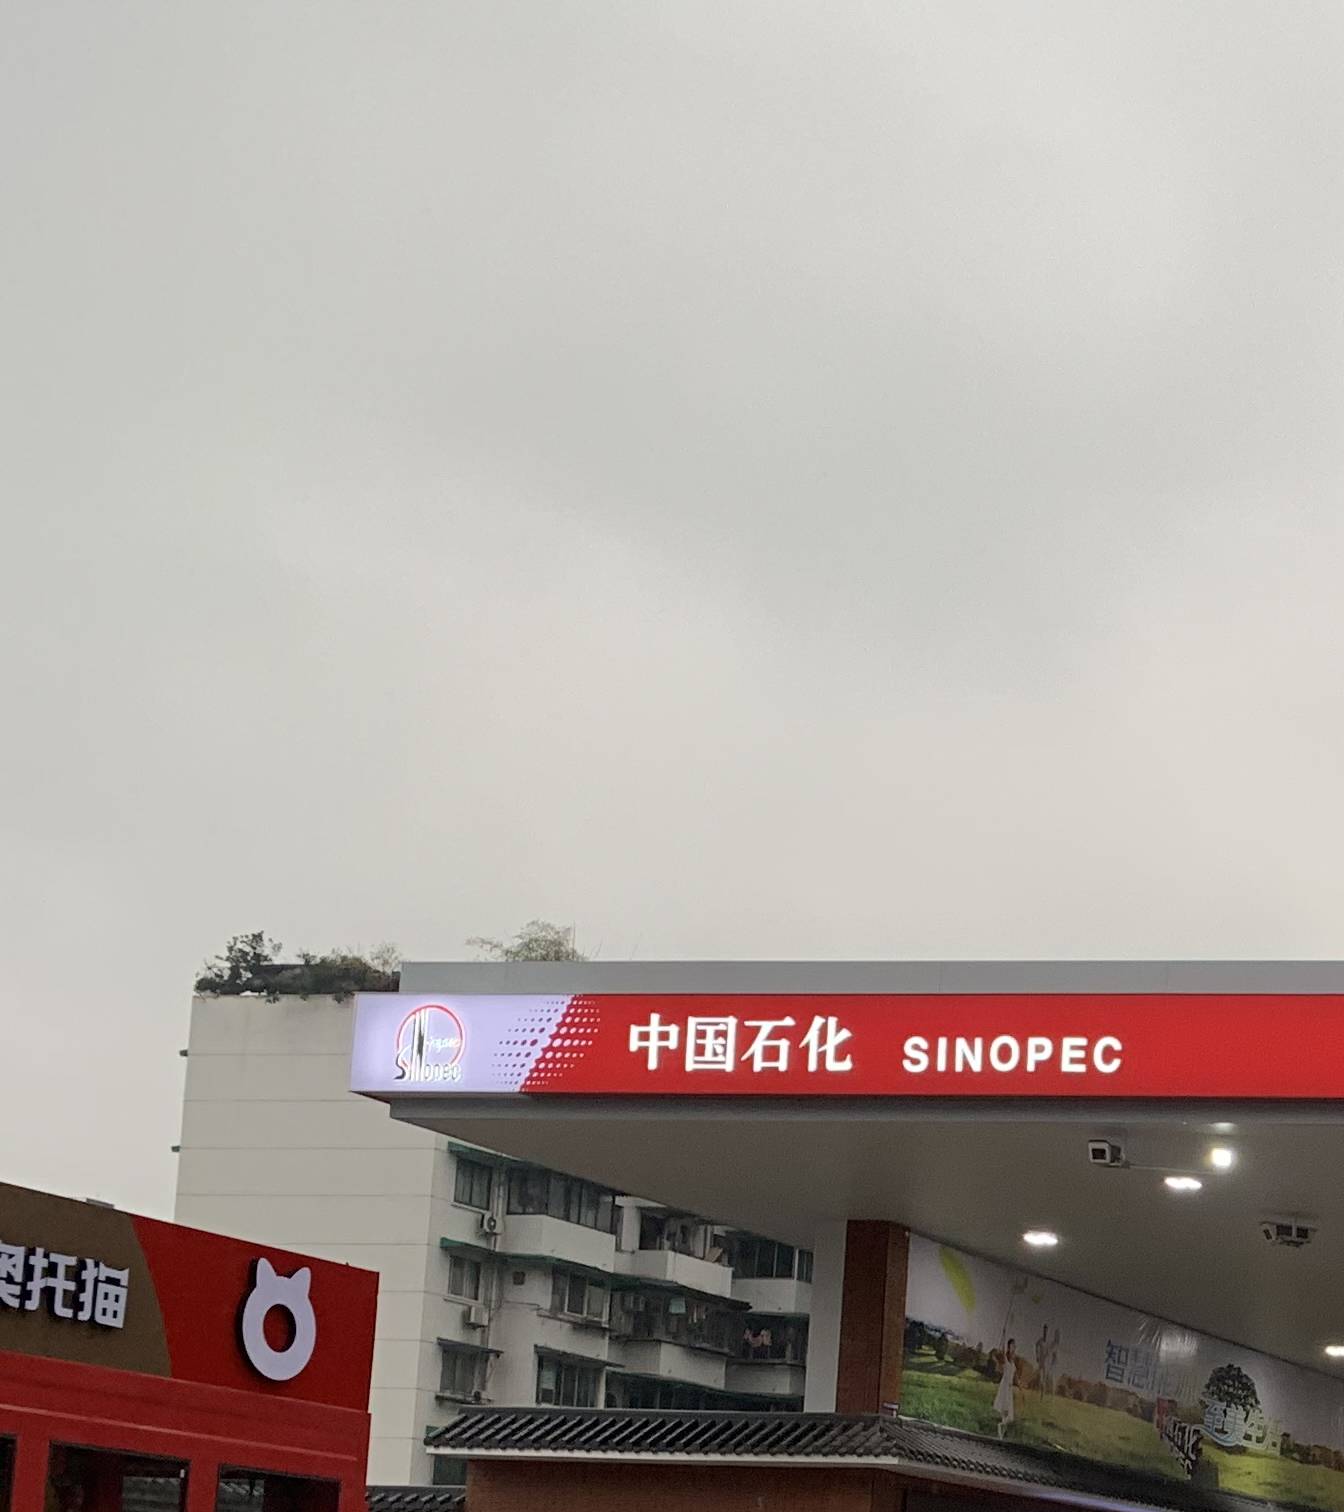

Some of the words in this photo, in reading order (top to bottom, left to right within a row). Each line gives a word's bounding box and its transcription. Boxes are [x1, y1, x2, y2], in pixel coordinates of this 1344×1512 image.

[628, 1012, 853, 1073] 中国石化
[901, 1034, 1123, 1074] SINOPEC
